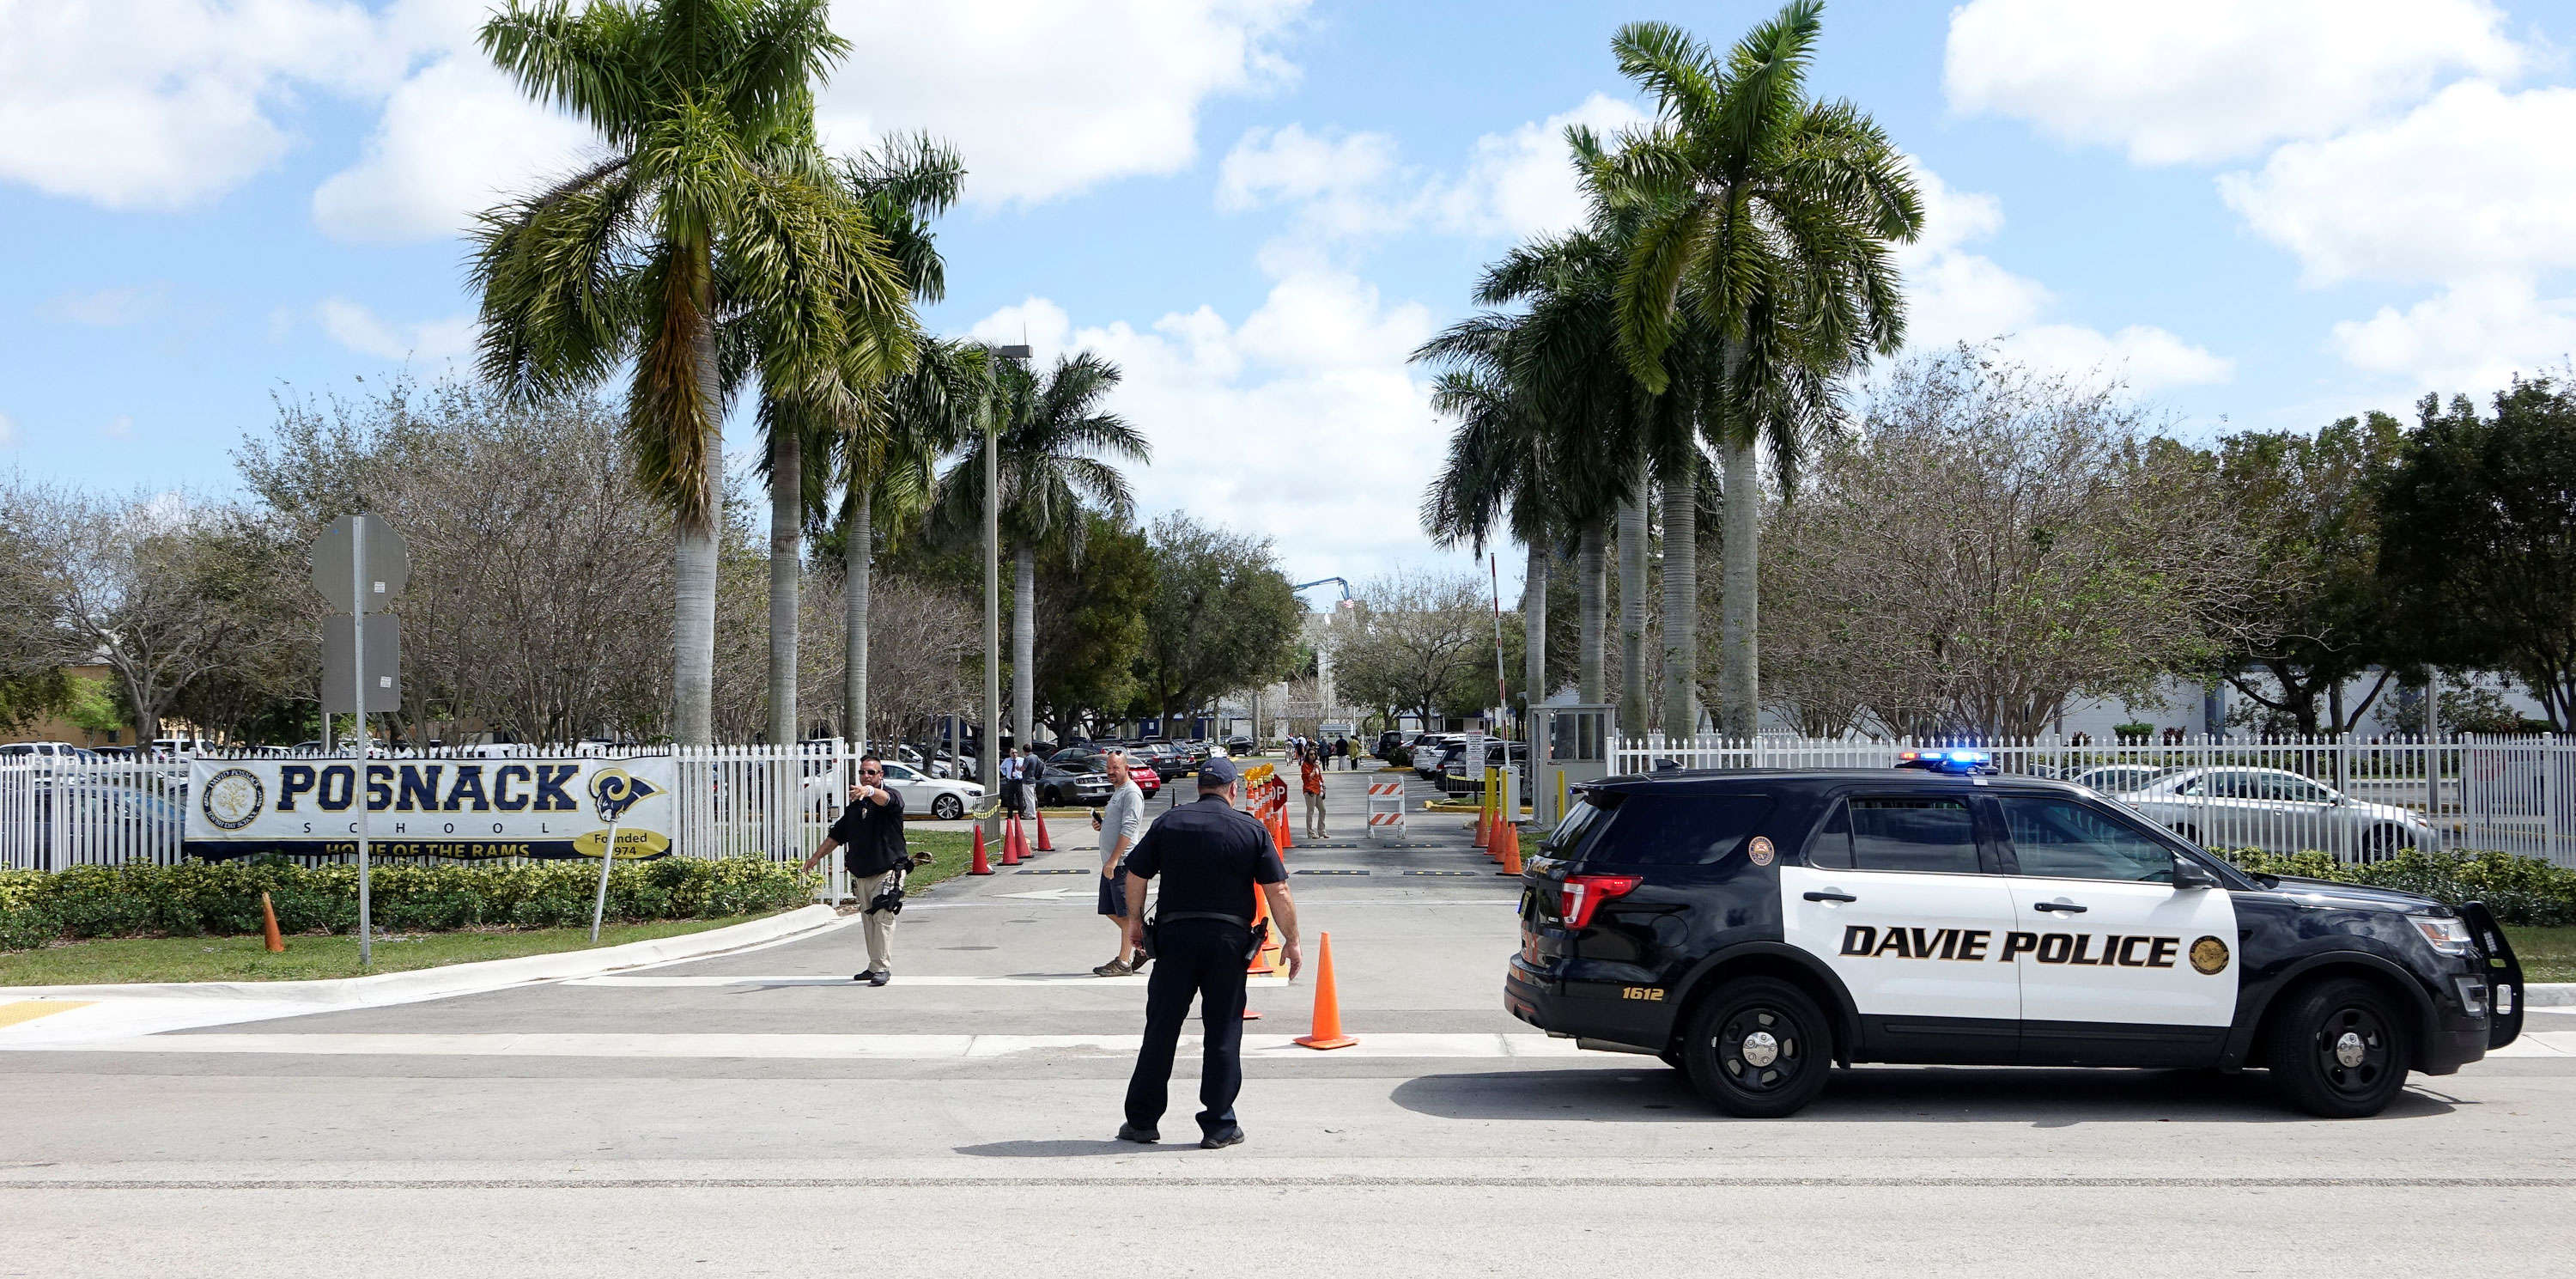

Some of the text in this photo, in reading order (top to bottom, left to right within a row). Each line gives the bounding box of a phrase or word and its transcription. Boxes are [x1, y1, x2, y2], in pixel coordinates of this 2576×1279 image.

[209, 770, 229, 789] DAVID
[275, 764, 580, 813] POSNACK
[1271, 786, 1285, 801] OP
[303, 822, 550, 834] SCHOOL
[594, 832, 647, 844] Fonded
[392, 844, 420, 856] OF
[426, 844, 465, 857] THE
[472, 844, 530, 857] RAMS
[614, 846, 637, 856] 974
[1838, 924, 1992, 961] DAVIE
[1998, 930, 2181, 969] POLICE
[1623, 987, 1665, 1002] 1612
